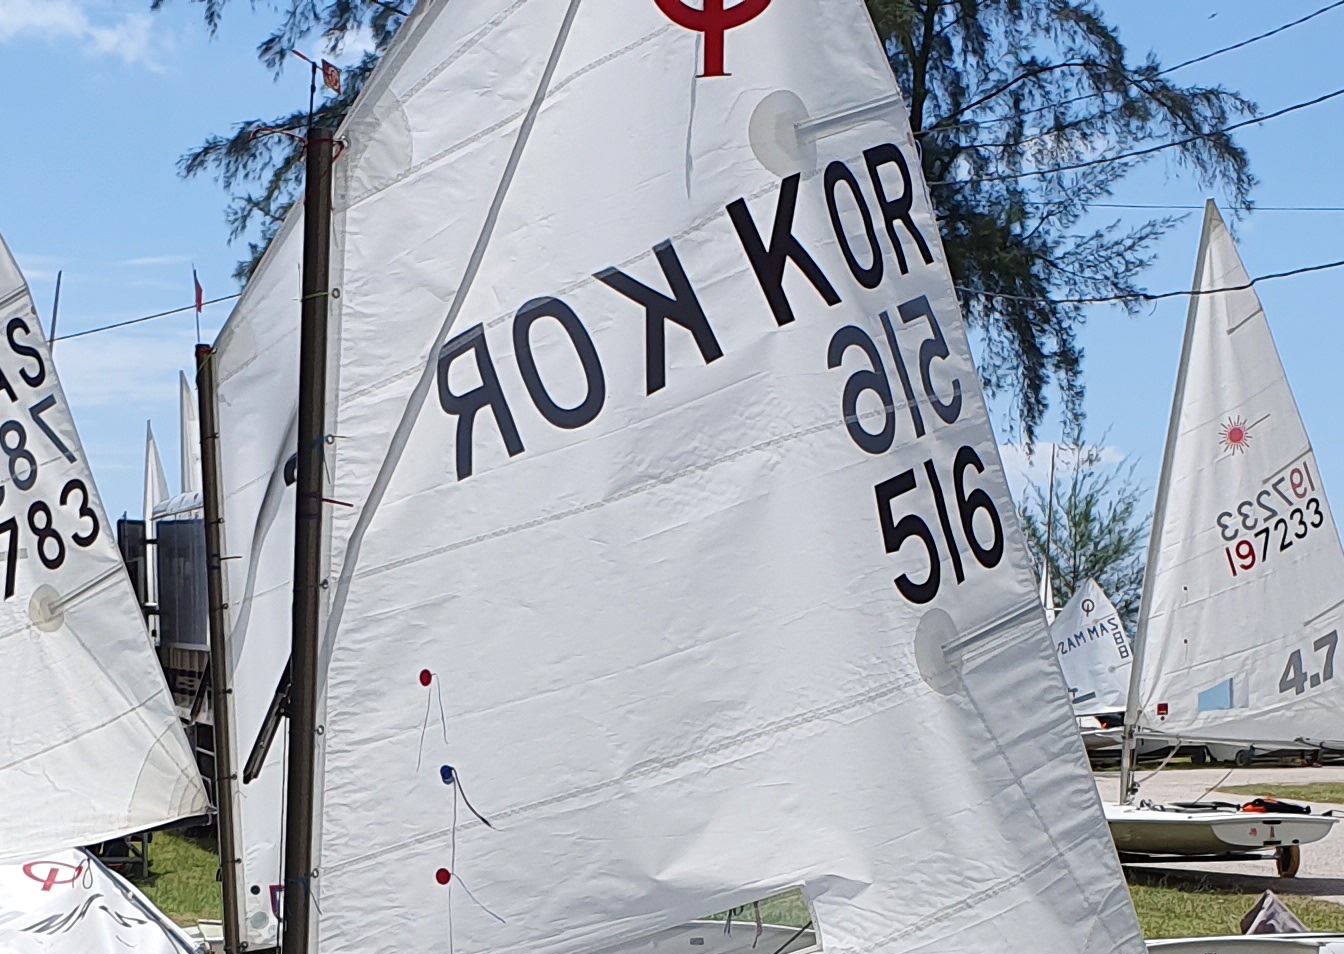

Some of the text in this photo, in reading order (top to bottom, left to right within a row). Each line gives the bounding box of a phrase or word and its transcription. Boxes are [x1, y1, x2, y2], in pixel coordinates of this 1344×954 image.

[726, 142, 934, 327] KOR
[875, 446, 1004, 604] 516
[1225, 498, 1324, 577] 197233
[1087, 617, 1119, 641] MAS
[1278, 629, 1339, 695] 4.7
